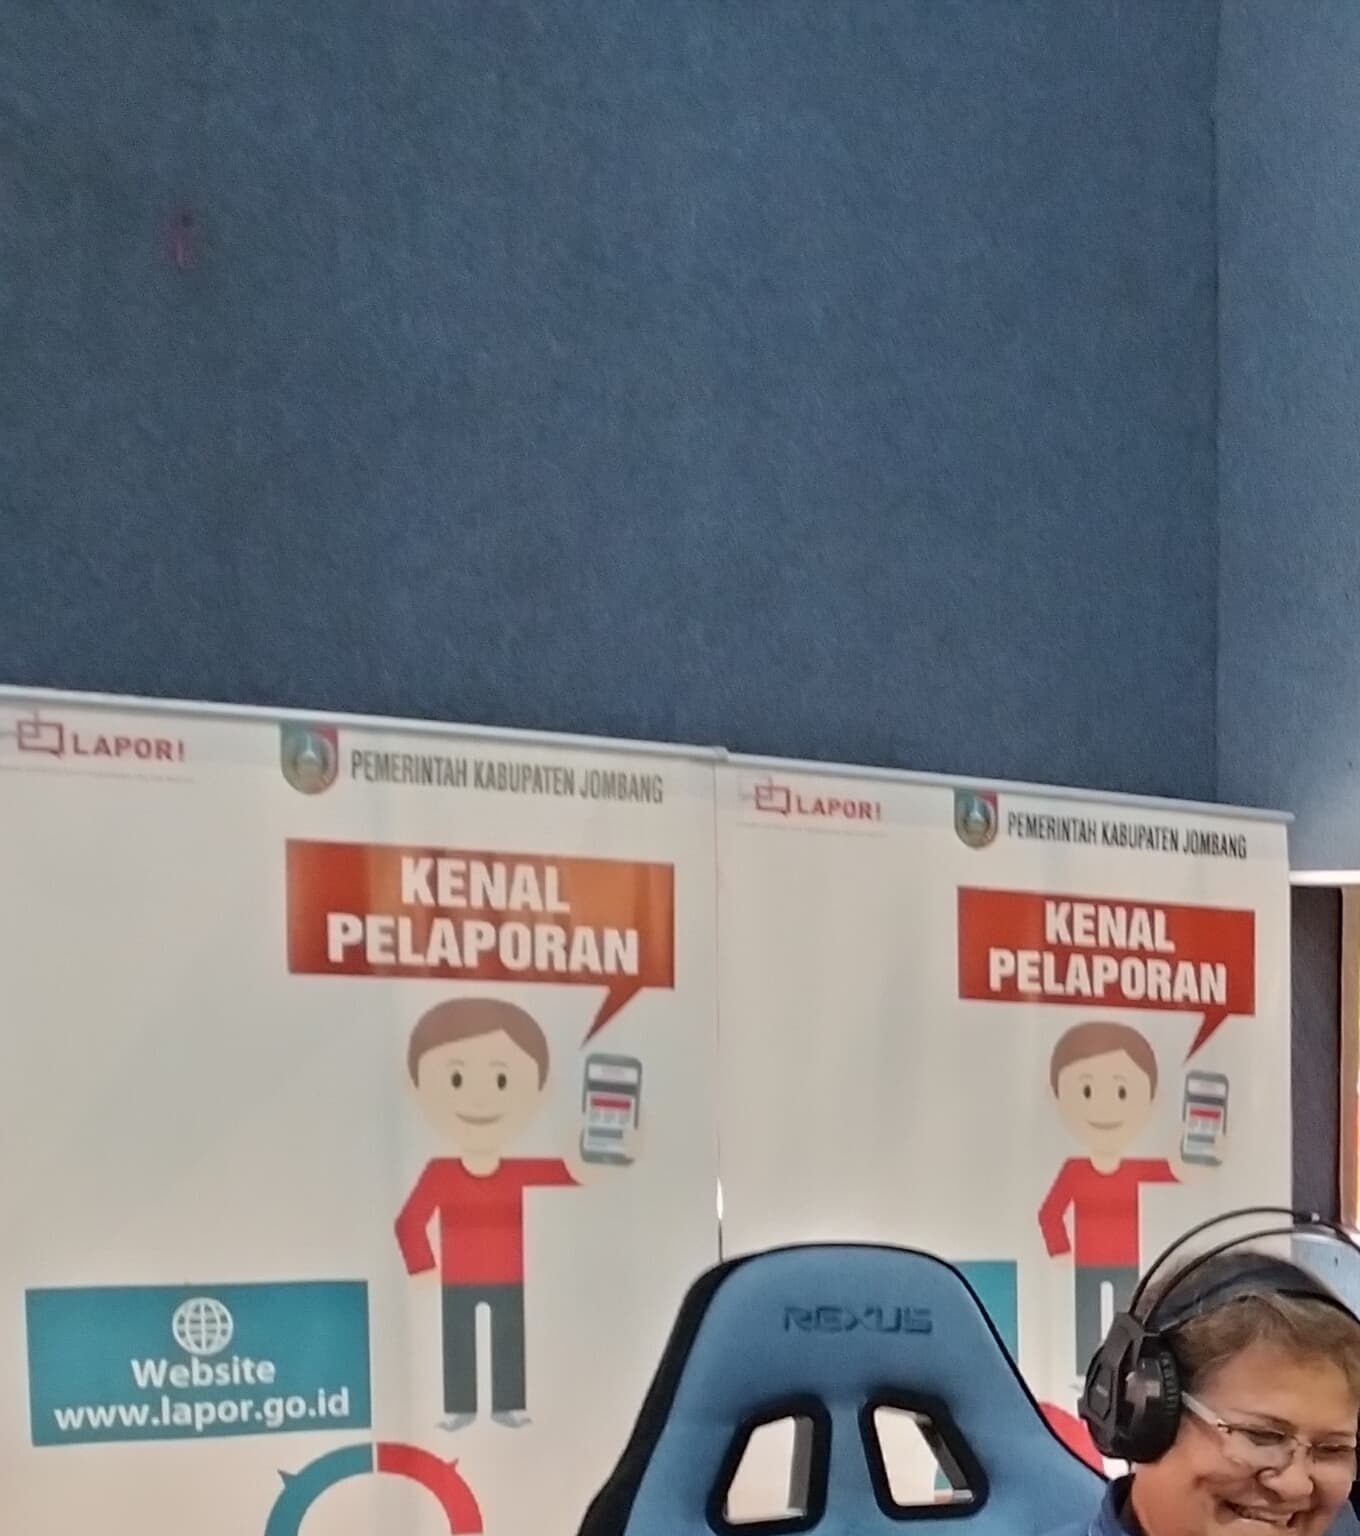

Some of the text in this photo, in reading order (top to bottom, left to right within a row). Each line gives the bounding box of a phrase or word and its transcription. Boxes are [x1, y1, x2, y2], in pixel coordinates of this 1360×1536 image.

[351, 750, 664, 805] PEMERINTAH KABUPATEN JOMBANG
[1007, 811, 1248, 860] PEMERINTAH KABUPATEN JOMBANG
[400, 856, 571, 914] KENAL
[326, 912, 639, 976] PELAPORAN
[1044, 900, 1176, 953] KENAL
[988, 946, 1228, 1006] PELAPORAN
[130, 1355, 277, 1390] Website
[54, 1386, 350, 1432] www.lapor.go.id
